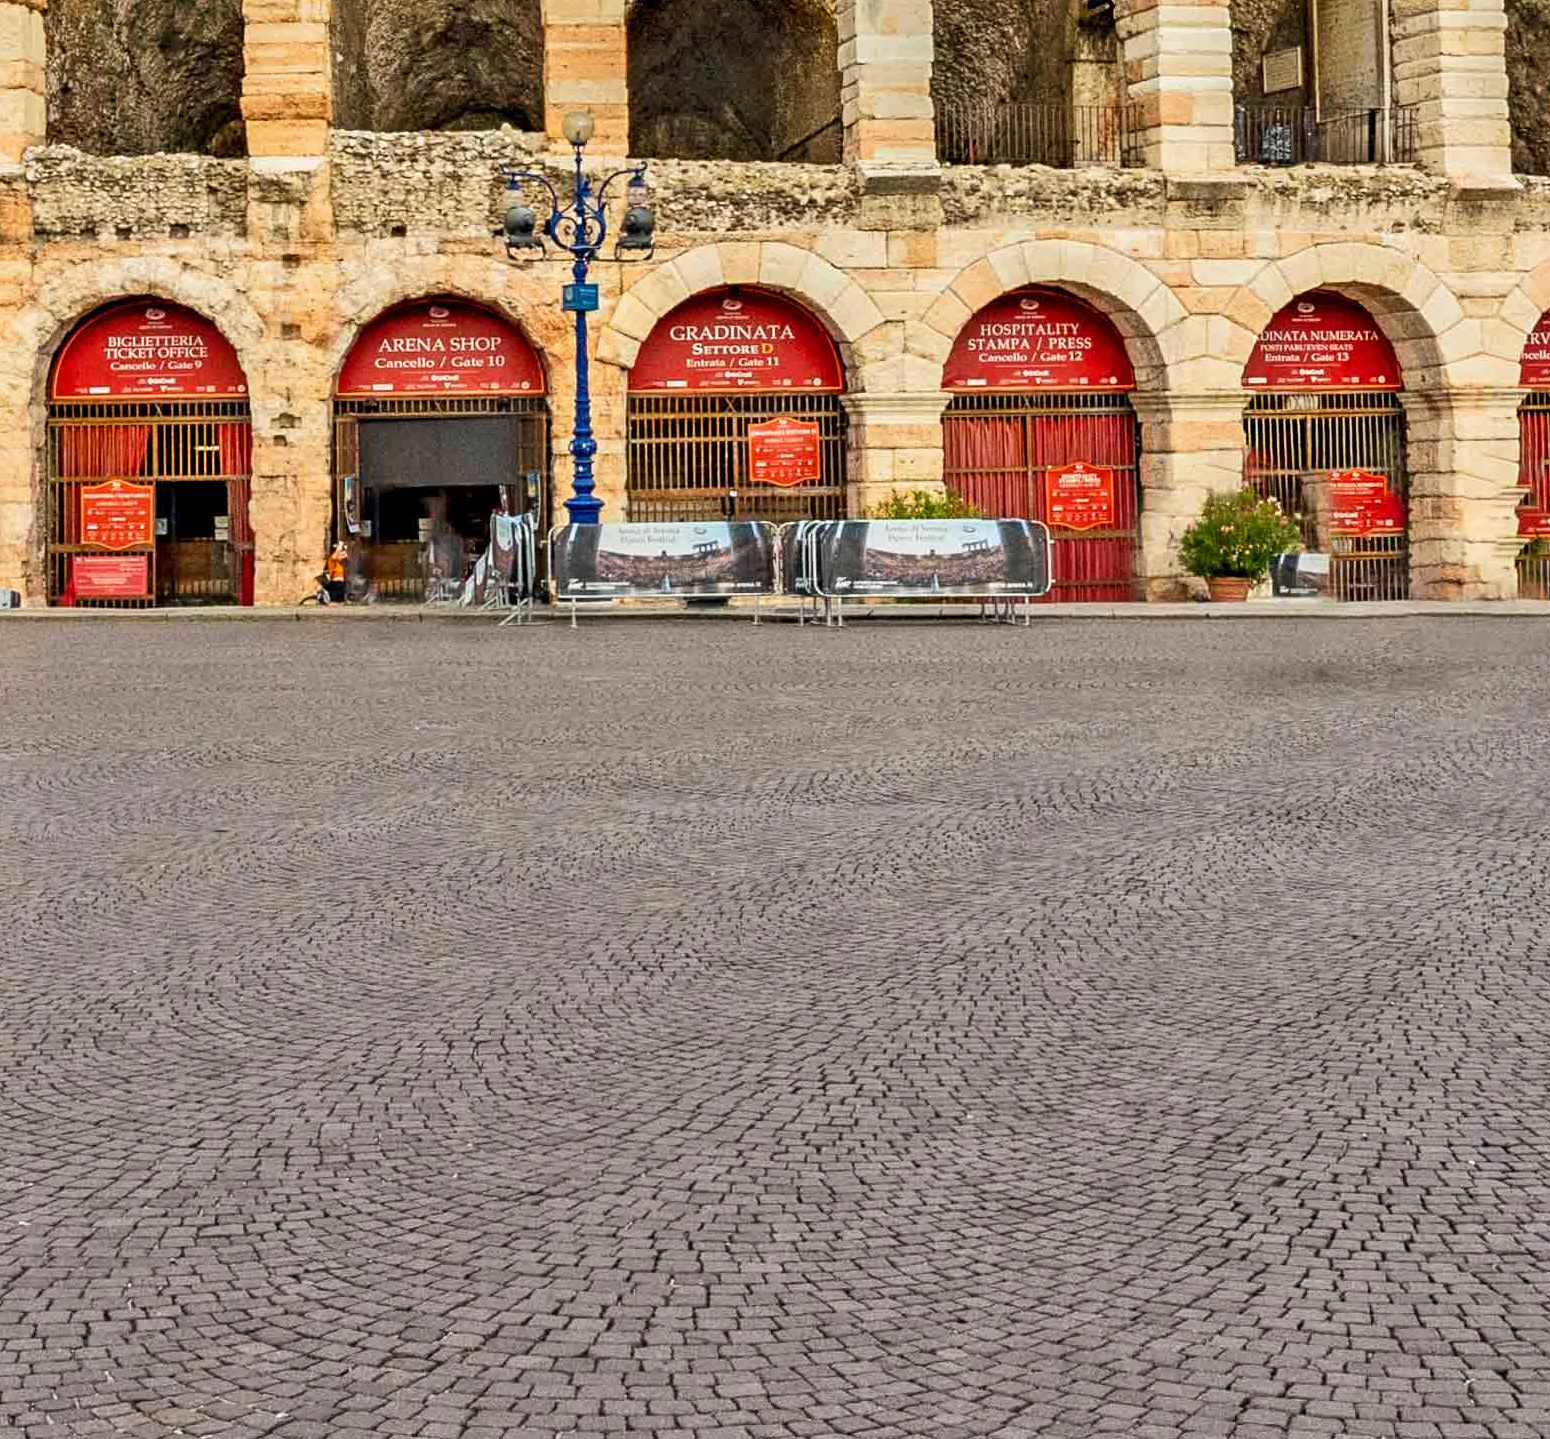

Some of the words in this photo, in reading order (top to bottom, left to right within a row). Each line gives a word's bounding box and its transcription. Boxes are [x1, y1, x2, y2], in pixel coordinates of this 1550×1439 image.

[670, 325, 795, 341] GRADINATA
[980, 323, 1079, 336] HOSPITALITY
[1258, 331, 1308, 341] DINATA
[1311, 330, 1379, 341] NUMERATA
[108, 336, 203, 348] BIGLIETTERIA
[379, 338, 446, 353] ARENA
[450, 337, 502, 352] SHOP
[968, 337, 1030, 350] STAMPA
[1036, 337, 1043, 350] /
[1048, 337, 1092, 349] PRESS
[104, 347, 156, 359] TICKET
[157, 347, 208, 358] OFFICE
[692, 343, 759, 355] SETTORE
[761, 342, 774, 354] D
[374, 357, 435, 369] Cancello
[451, 356, 484, 368] Gate
[488, 355, 505, 367] 10
[686, 358, 725, 368] Entrata
[738, 357, 764, 367] Gate
[766, 357, 779, 366] 11
[978, 352, 1027, 362] Cancello
[1040, 352, 1067, 361] Gate
[1069, 351, 1083, 361] 12
[1265, 353, 1300, 362] Entrata
[1311, 353, 1335, 362] Gate
[1337, 352, 1350, 361] 13
[110, 361, 156, 371] Cancello
[168, 360, 193, 370] Gate
[194, 360, 203, 370] 9
